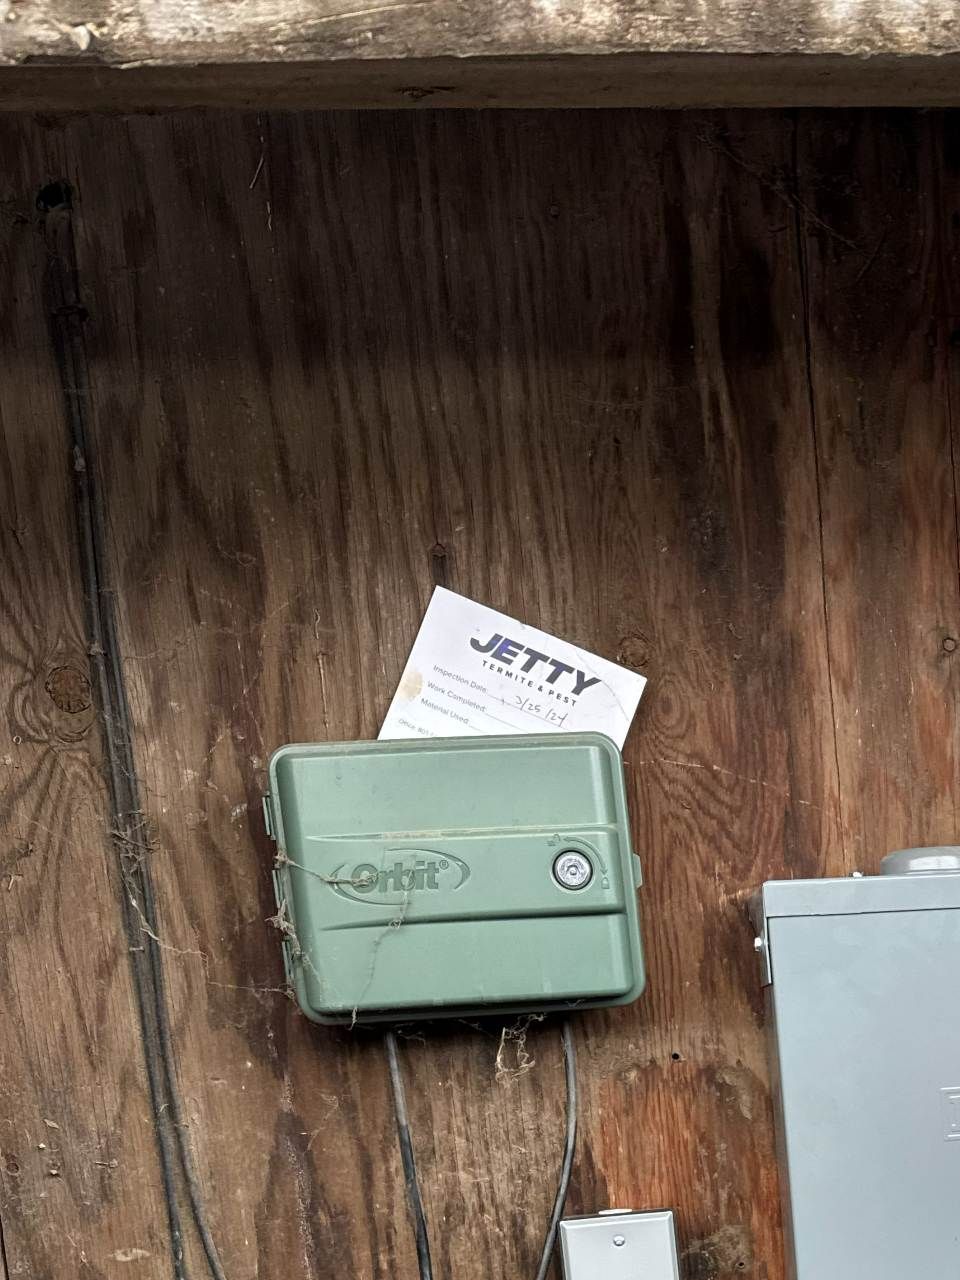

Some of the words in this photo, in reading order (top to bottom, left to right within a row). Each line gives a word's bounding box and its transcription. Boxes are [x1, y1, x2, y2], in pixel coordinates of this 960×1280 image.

[433, 664, 470, 686] Inspection
[469, 633, 602, 696] JETTY
[427, 680, 446, 695] Work
[482, 660, 534, 688] TERMITE
[548, 689, 578, 707] PEST
[420, 697, 450, 716] Material
